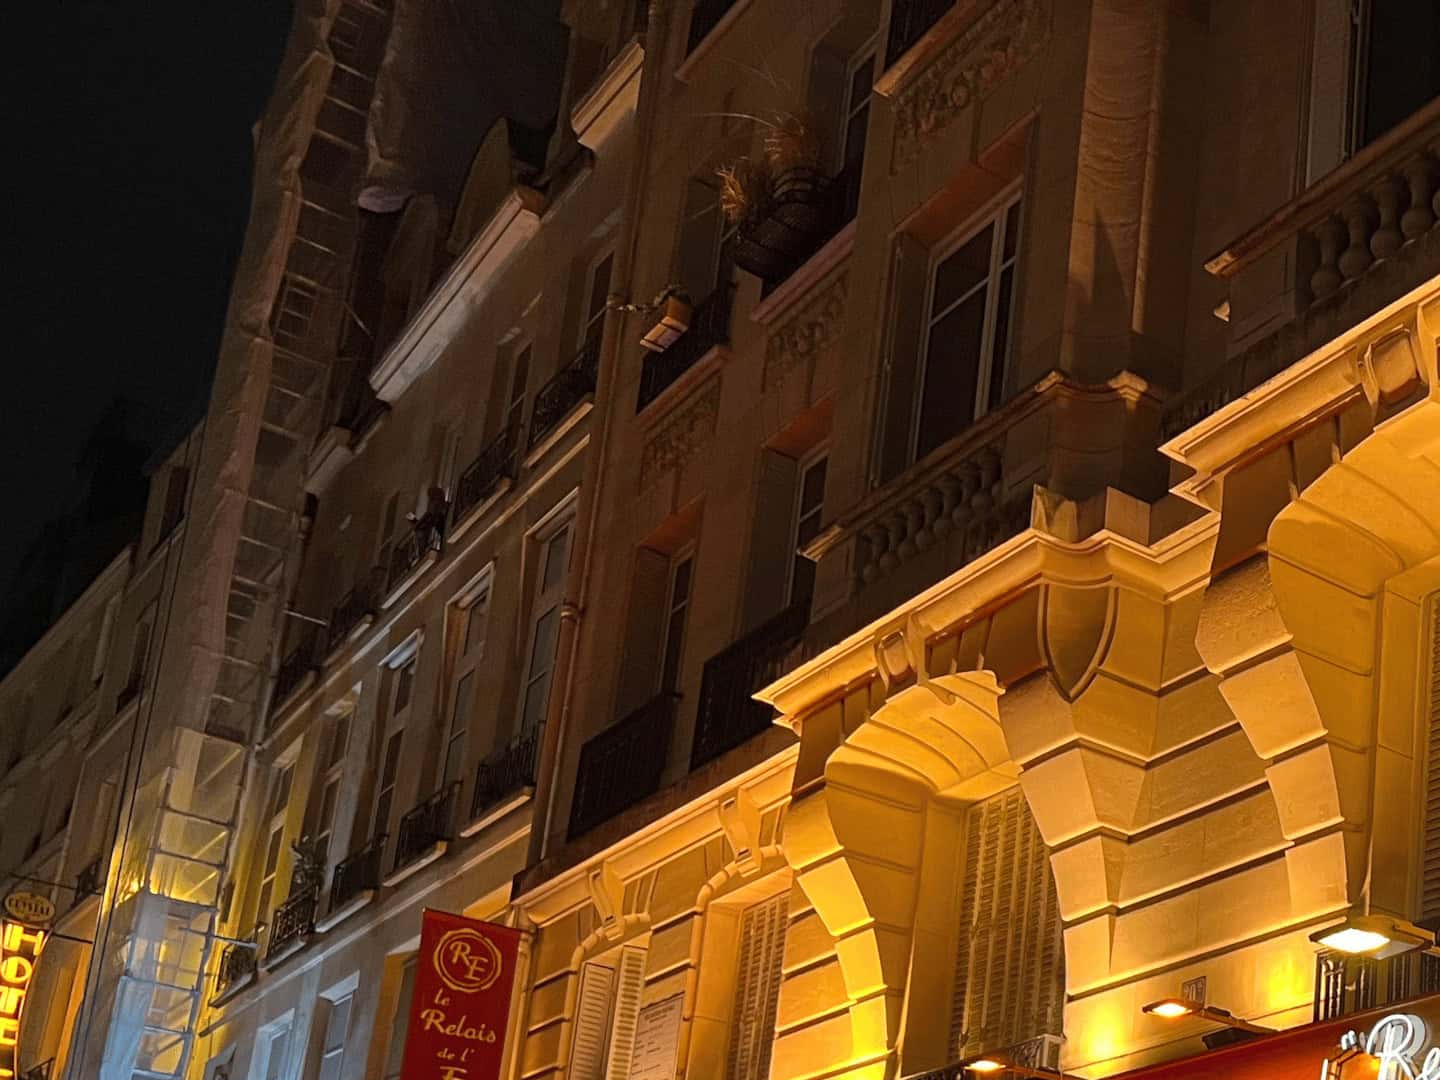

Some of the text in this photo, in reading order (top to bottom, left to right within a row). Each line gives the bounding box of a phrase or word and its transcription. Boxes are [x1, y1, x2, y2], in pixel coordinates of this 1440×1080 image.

[0, 922, 44, 1078] HOTE
[434, 987, 451, 1006] le
[420, 1008, 497, 1043] Relais
[437, 1047, 455, 1061] de
